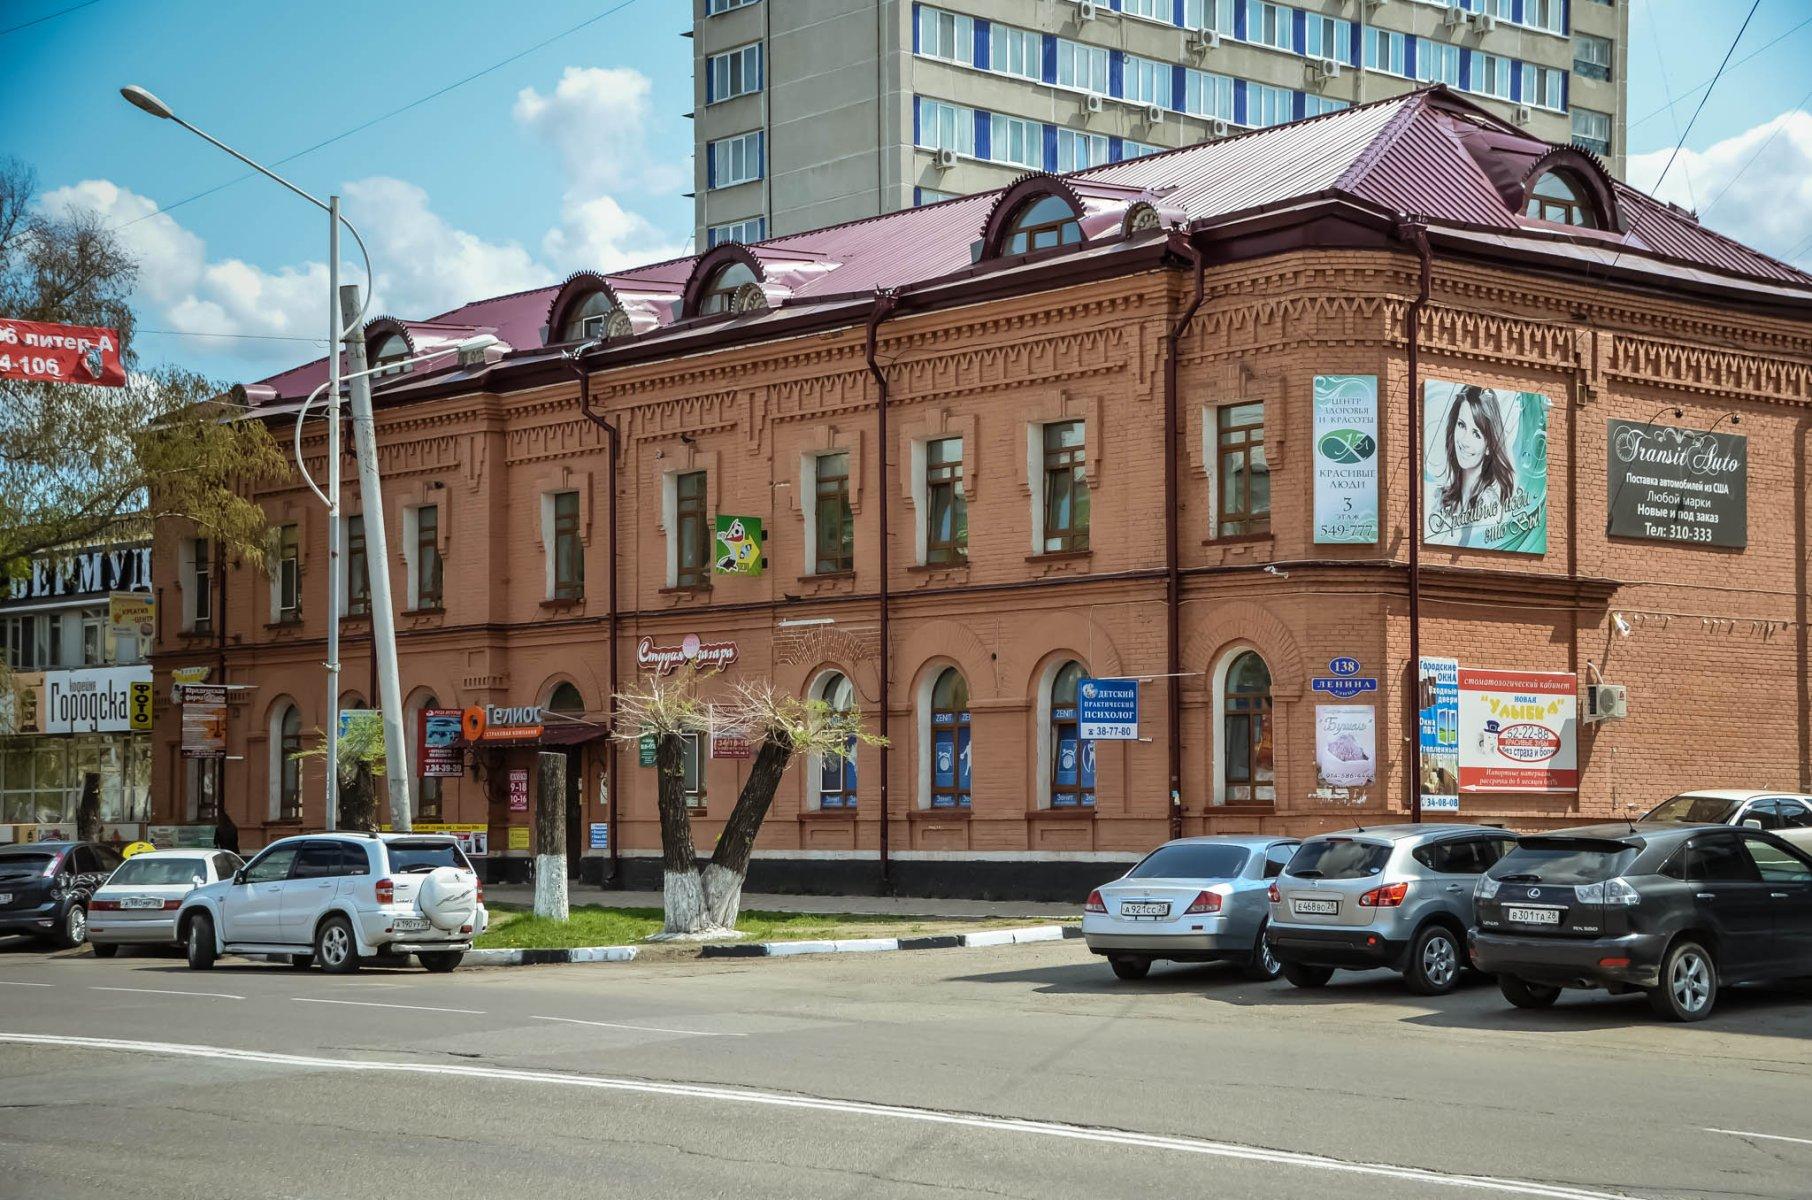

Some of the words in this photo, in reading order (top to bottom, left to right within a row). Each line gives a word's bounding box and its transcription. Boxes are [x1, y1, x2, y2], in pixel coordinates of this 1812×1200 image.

[25, 333, 92, 354] литер
[1324, 407, 1369, 415] ЗДОРОВЬЯ
[1614, 426, 1688, 466] Transit
[1687, 434, 1741, 475] Auto
[1319, 469, 1376, 478] КРАСИВЫЕ
[1330, 480, 1366, 489] ЛЮДИ
[1626, 472, 1659, 487] Поставка
[1659, 479, 1703, 492] автомобилей
[1704, 483, 1712, 492] из
[1713, 484, 1730, 494] США
[1646, 490, 1680, 504] Любой
[1683, 497, 1712, 509] марки
[1343, 497, 1353, 512] 3
[1637, 503, 1668, 518] Новые
[1669, 509, 1676, 519] и
[1677, 510, 1695, 522] под
[1696, 512, 1719, 524] заказ
[1320, 525, 1373, 537] 549-777
[1644, 522, 1667, 538] Тел:
[1669, 524, 1713, 542] 310-333
[639, 641, 684, 675] Студия
[696, 648, 735, 667] загара
[1335, 661, 1355, 672] 138
[1420, 660, 1457, 671] Городские
[1438, 673, 1457, 682] ОКНА
[1317, 680, 1371, 689] ЛЕНИНА
[1464, 678, 1538, 689] стоматологический
[1540, 680, 1570, 690] кабинет
[1099, 690, 1134, 699] ДЕТСКИЙ
[1428, 686, 1457, 695] Входные
[134, 684, 150, 723] ФОТО
[1437, 697, 1458, 705] двери
[1514, 695, 1537, 703] НОВАЯ
[486, 704, 543, 725] Гелиос
[935, 713, 953, 722] ZENIT
[1056, 709, 1074, 718] ZENIT
[1084, 711, 1135, 719] ПСИХОЛОГ
[1420, 718, 1436, 726] Окна
[1096, 726, 1131, 736] 38-77-80
[1423, 727, 1436, 735] ПВХ
[1507, 727, 1550, 739] 52-22-88
[1513, 747, 1534, 757] страха
[510, 782, 527, 791] 9-18
[510, 795, 527, 803] 10-16
[1427, 798, 1458, 807] 34-08-08
